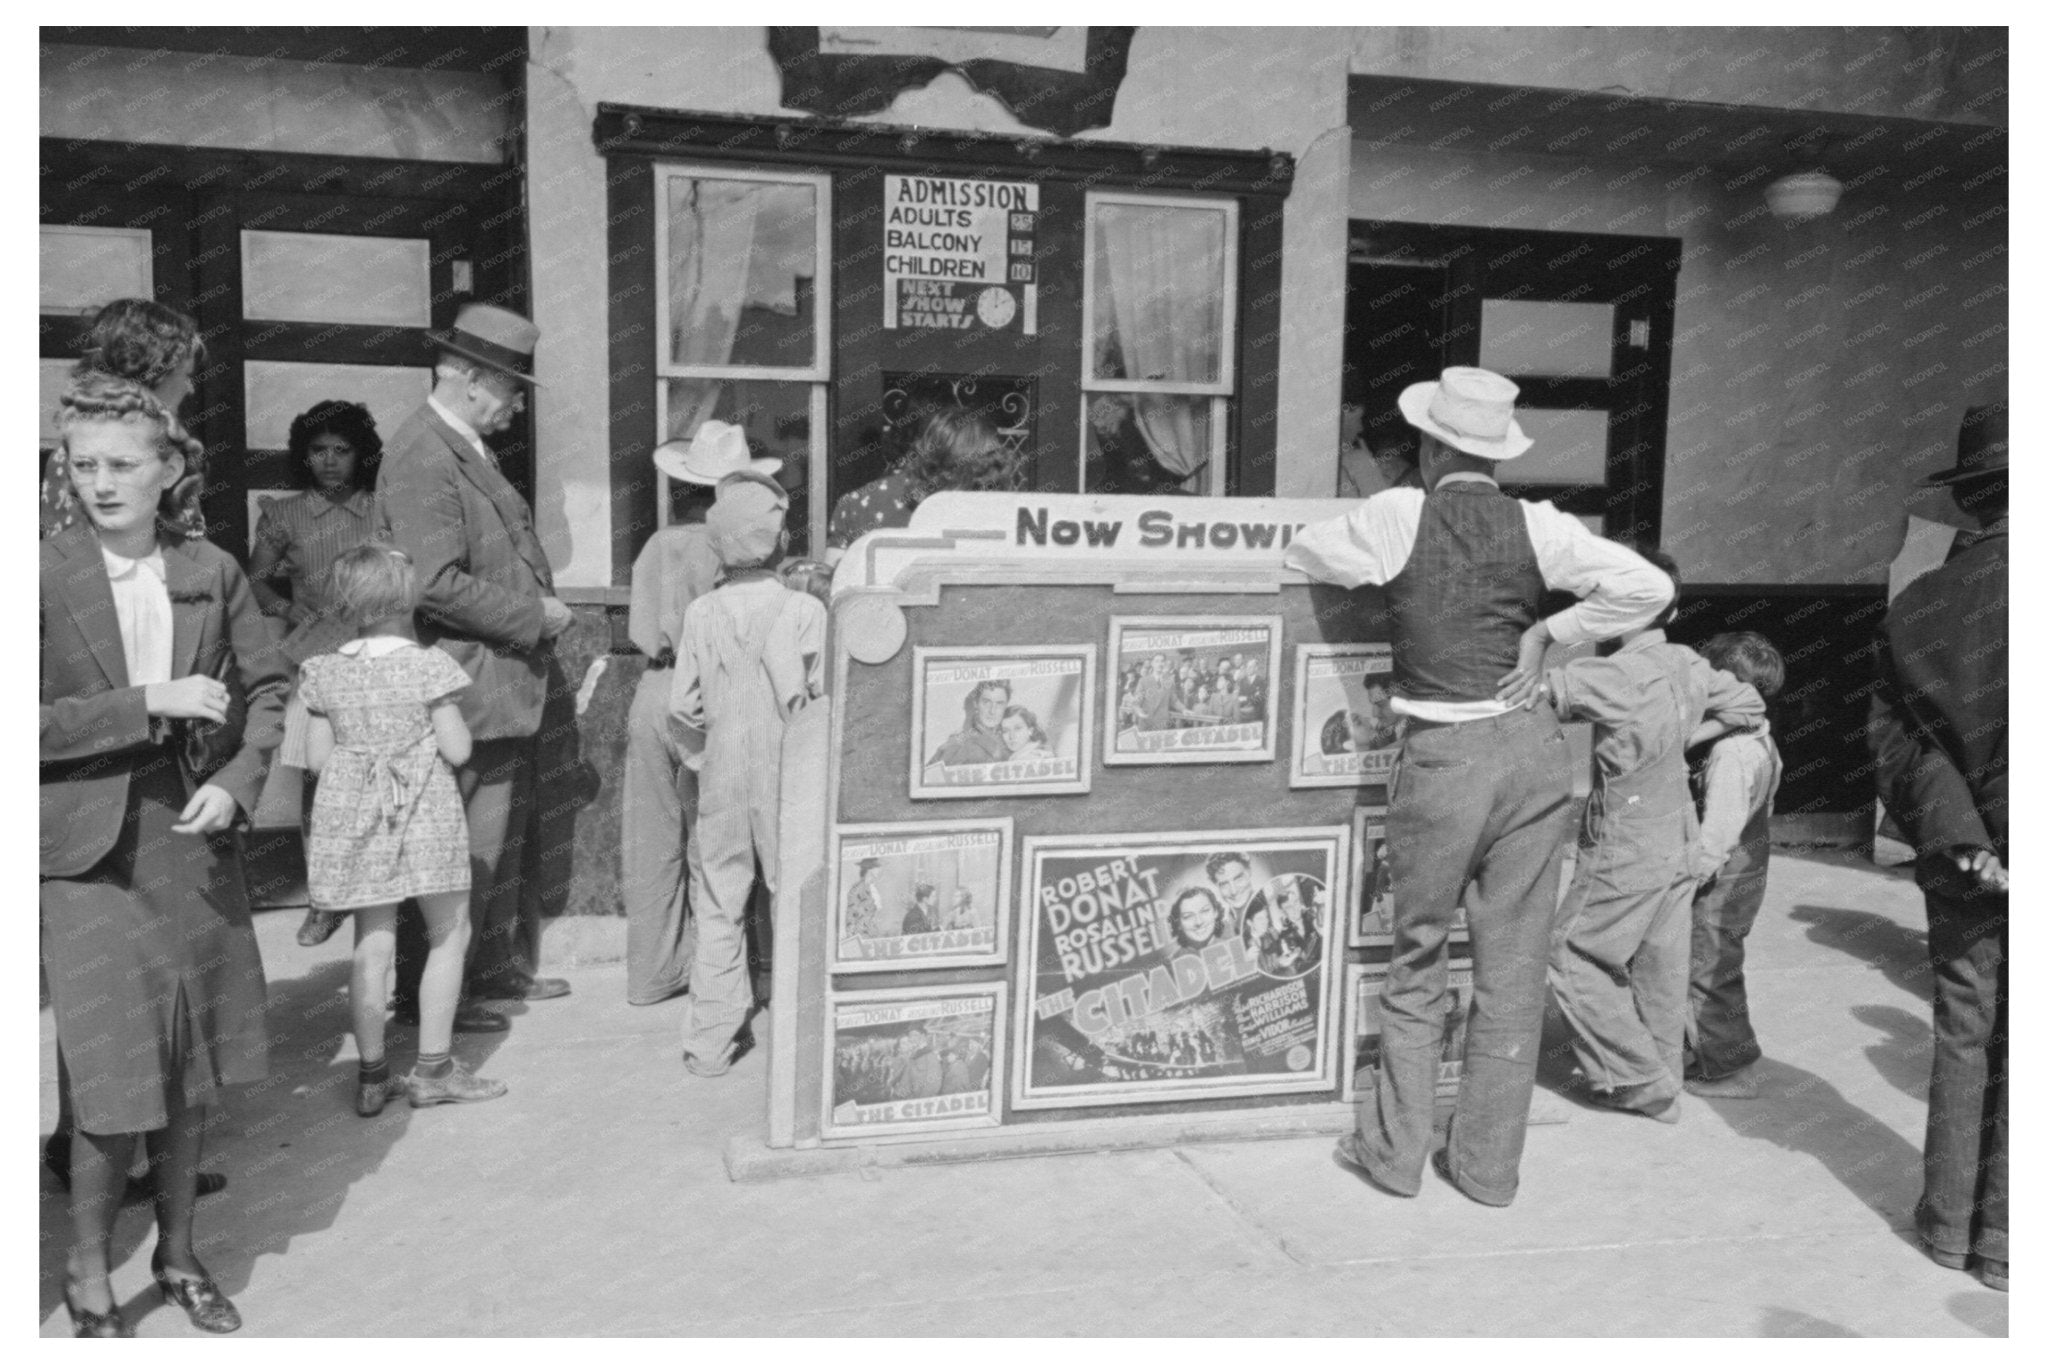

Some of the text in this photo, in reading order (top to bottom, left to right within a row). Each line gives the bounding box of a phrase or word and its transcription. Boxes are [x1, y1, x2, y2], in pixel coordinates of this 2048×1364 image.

[898, 178, 1029, 211] ADMISSION
[889, 206, 973, 228] ADULTS
[887, 230, 983, 253] BALCONY
[886, 255, 1030, 280] CHILDREN 10
[902, 280, 956, 297] NEXT
[904, 296, 967, 313] SHOW
[902, 313, 975, 329] STARTS
[1149, 635, 1183, 648] DONAT
[953, 667, 992, 681] DONAT
[1029, 660, 1082, 675] RUSSELL
[990, 760, 1076, 781] CITADEL
[870, 841, 908, 856] DONAT
[947, 833, 998, 848] RUSSELL
[1041, 855, 1139, 907] ROBERT
[1047, 868, 1159, 936] DONAT
[1054, 899, 1172, 957] ROSALIND
[906, 931, 995, 953] CITADEL
[1061, 922, 1180, 983] RUSSELL
[1033, 935, 1257, 1035] THE CITADEL
[864, 1009, 903, 1023] DONAT
[941, 999, 990, 1014] RUSSELL
[1250, 987, 1308, 1017] HARRISON
[1252, 999, 1310, 1027] WILLIAMS
[901, 1095, 988, 1117] CITADEL
